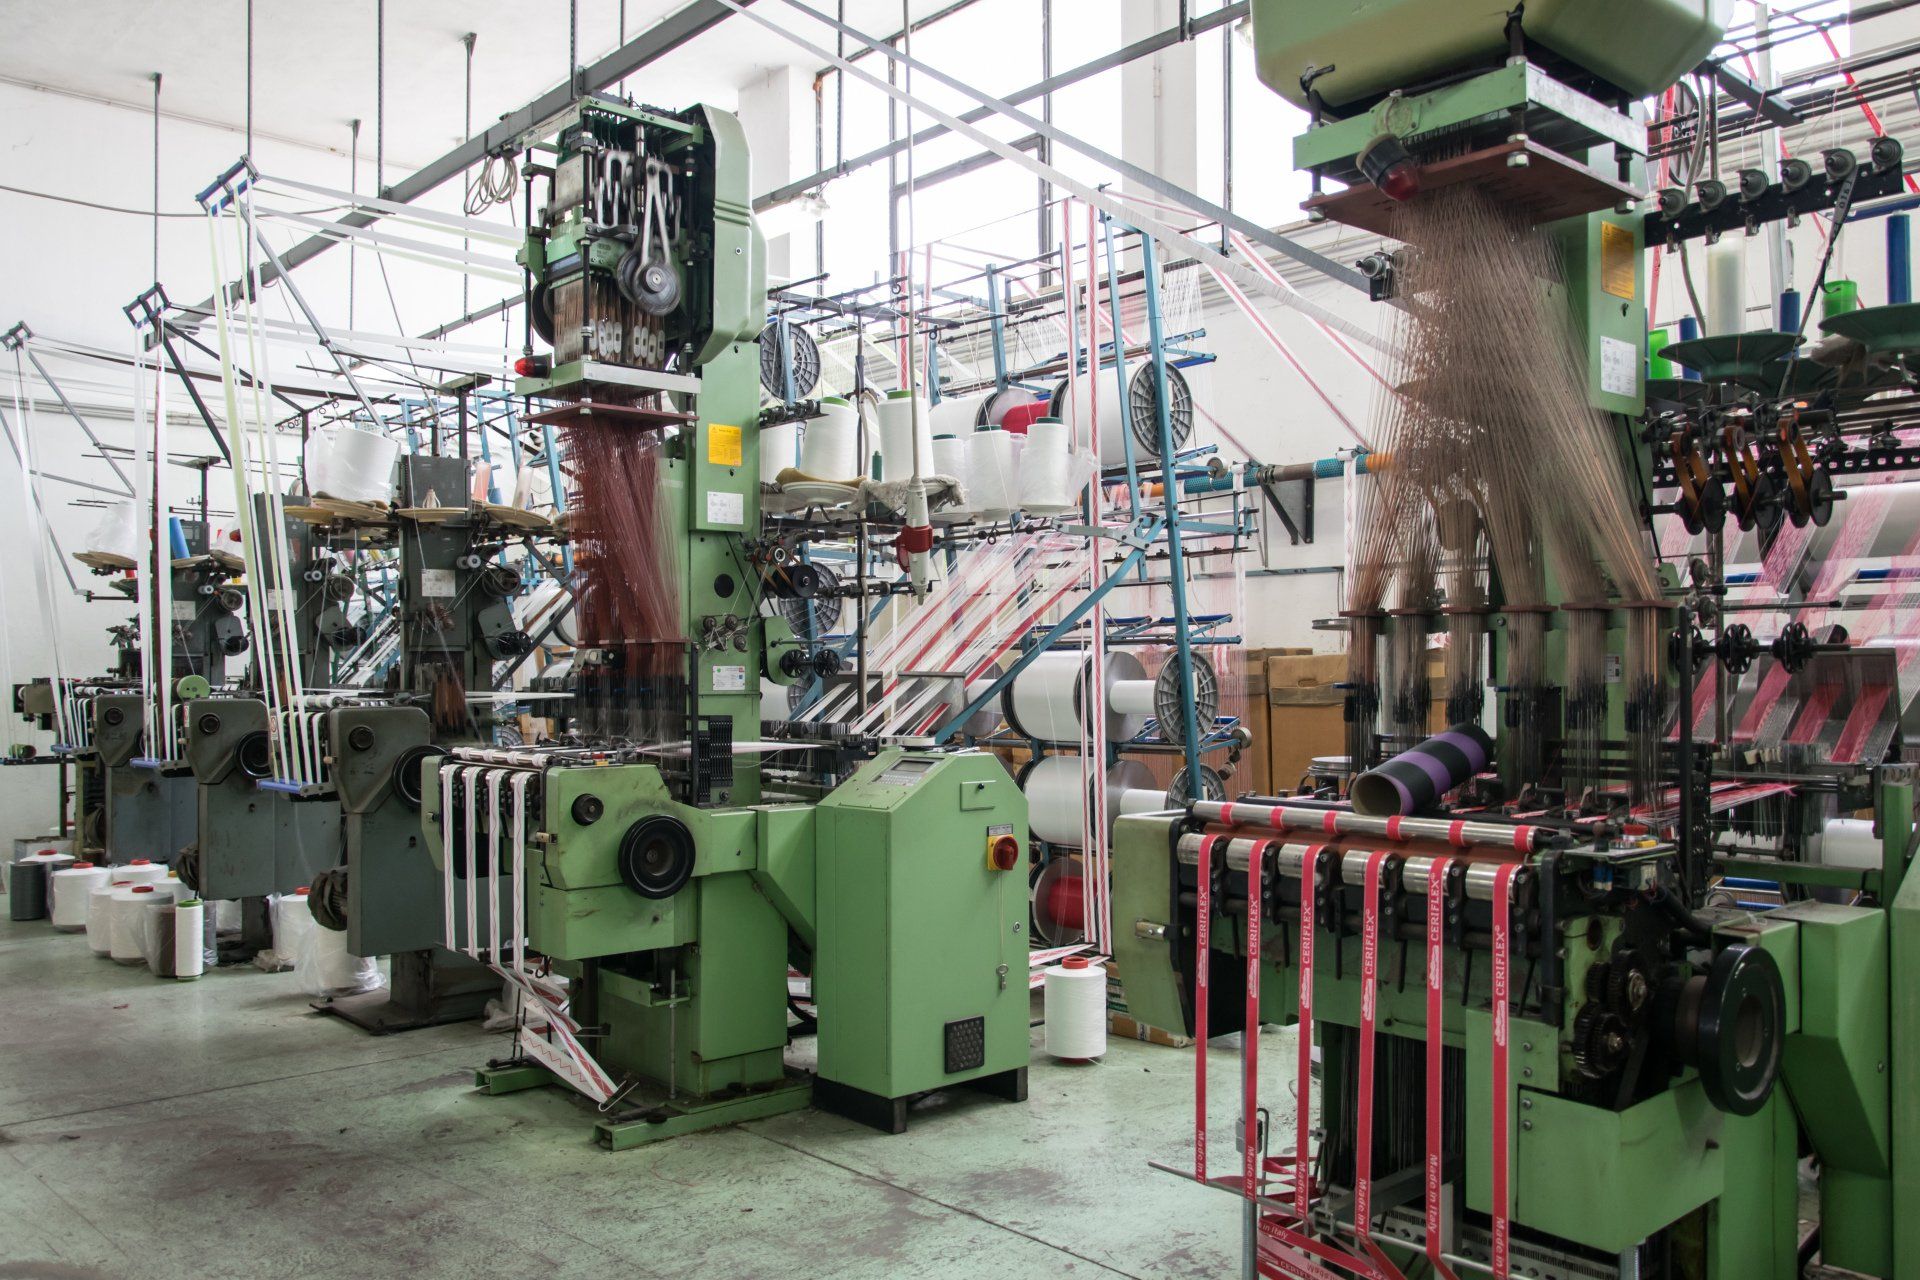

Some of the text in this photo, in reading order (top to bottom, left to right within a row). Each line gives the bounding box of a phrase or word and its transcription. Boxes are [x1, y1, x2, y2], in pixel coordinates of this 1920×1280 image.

[1358, 1177, 1367, 1212] Made
[1428, 1154, 1438, 1233] Made in Italy
[1495, 1216, 1505, 1253] Made
[1495, 1255, 1504, 1268] in
